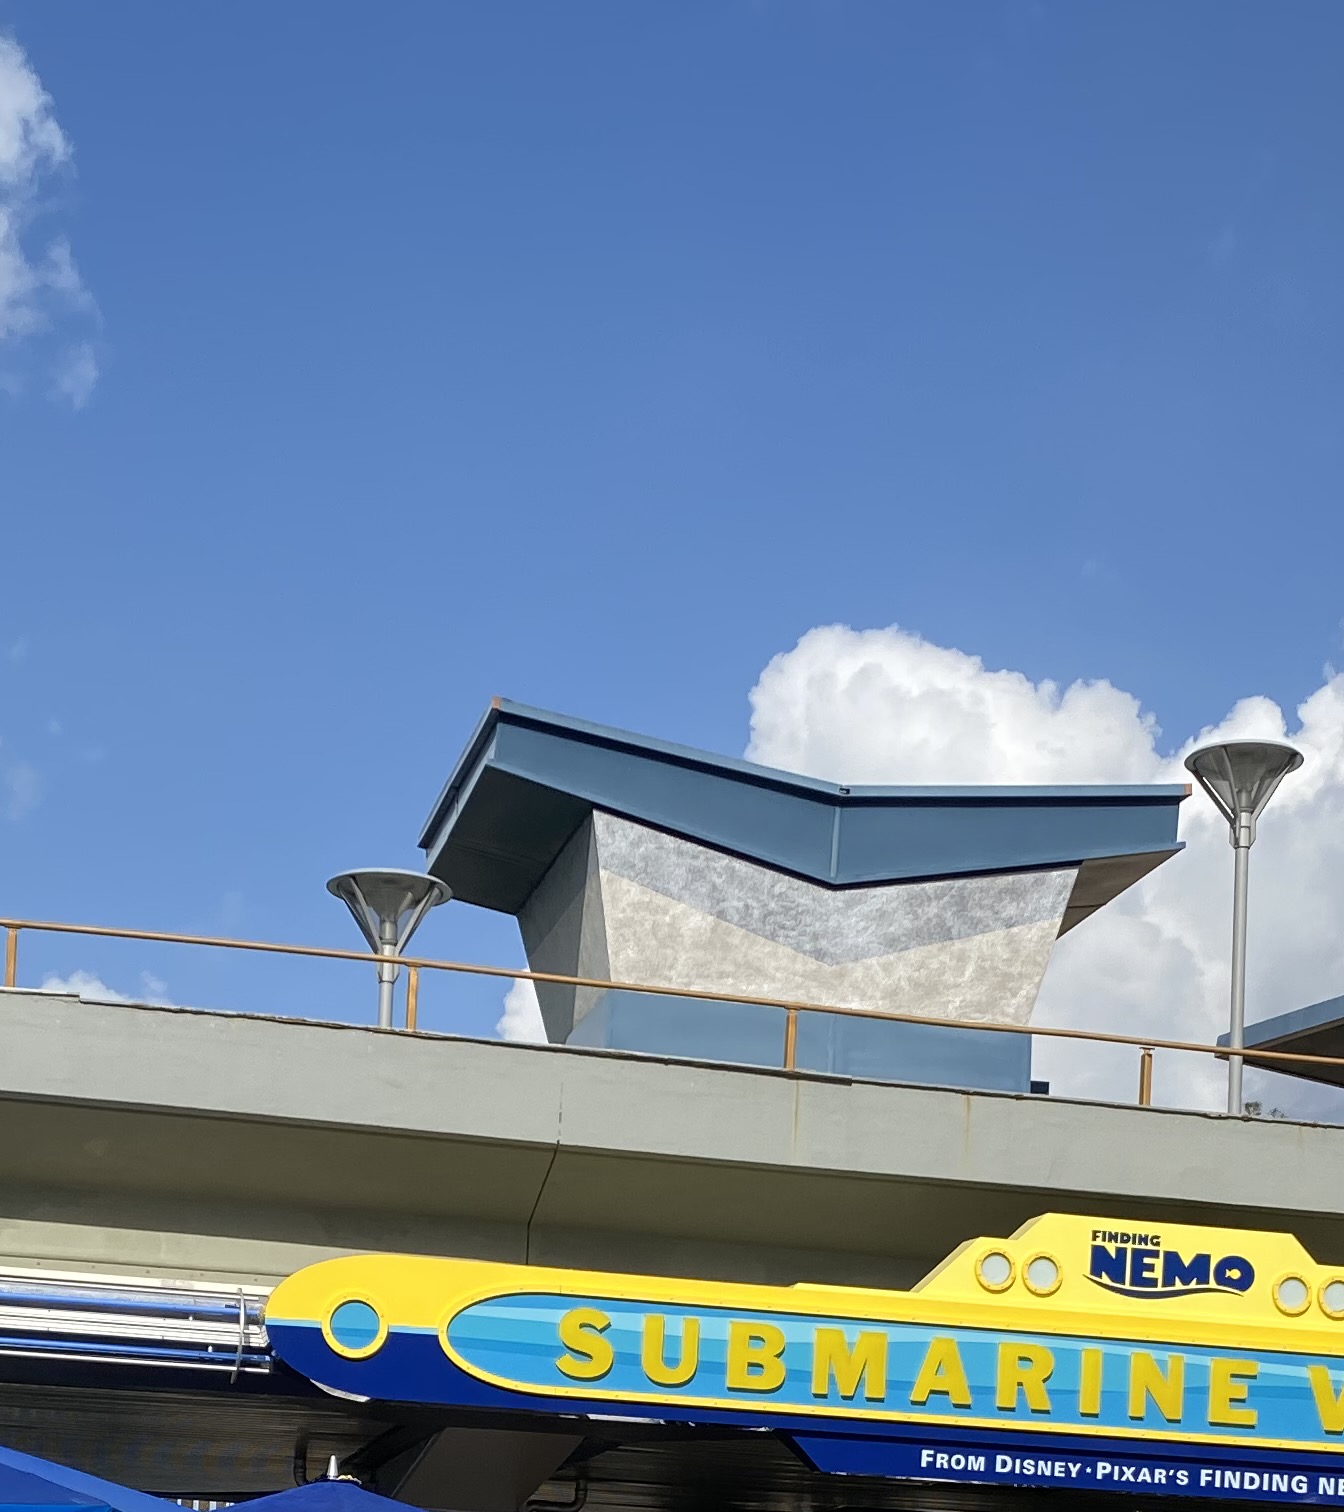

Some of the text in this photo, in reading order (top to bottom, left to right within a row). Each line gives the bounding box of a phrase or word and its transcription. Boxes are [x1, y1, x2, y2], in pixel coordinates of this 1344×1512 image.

[1091, 1230, 1161, 1247] FINDING
[1090, 1244, 1255, 1292] NEMO
[555, 1307, 1259, 1429] SUBMARINE
[920, 1449, 986, 1472] FROM
[1200, 1469, 1308, 1494] FINDING
